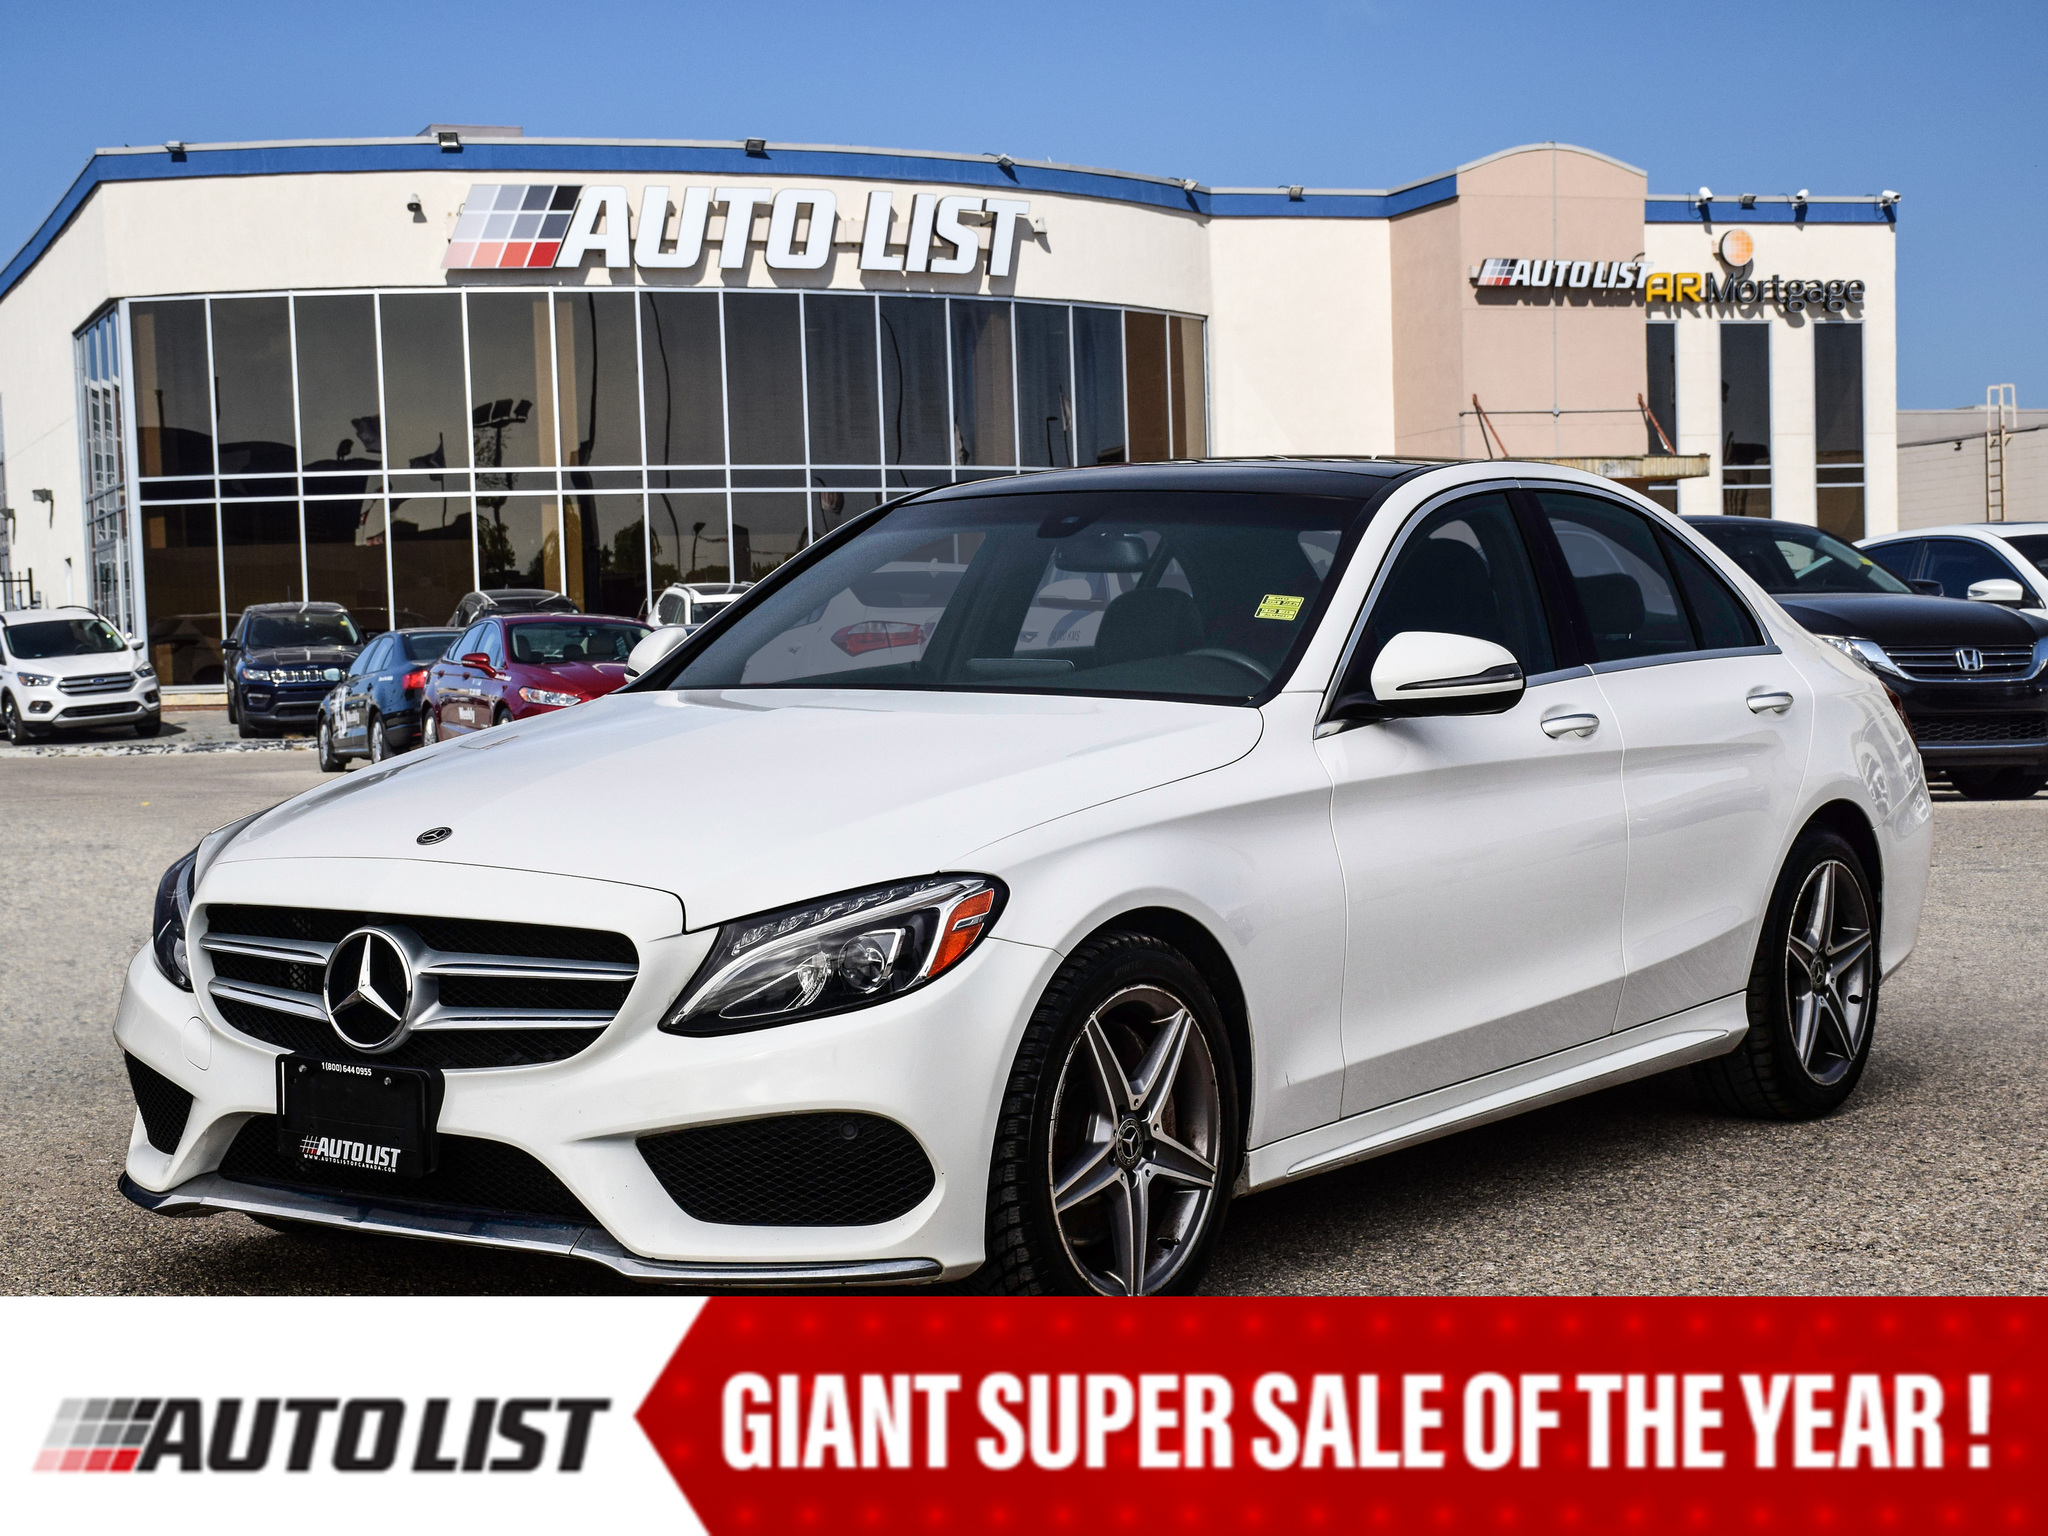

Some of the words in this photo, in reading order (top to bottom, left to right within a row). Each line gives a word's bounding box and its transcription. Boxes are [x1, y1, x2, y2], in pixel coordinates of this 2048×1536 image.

[555, 184, 838, 270] AUTO
[859, 190, 1032, 278] LIST
[1509, 259, 1592, 288] AUTO
[1592, 261, 1654, 289] LIST
[316, 1137, 365, 1162] AUTO
[365, 1144, 401, 1168] LIST
